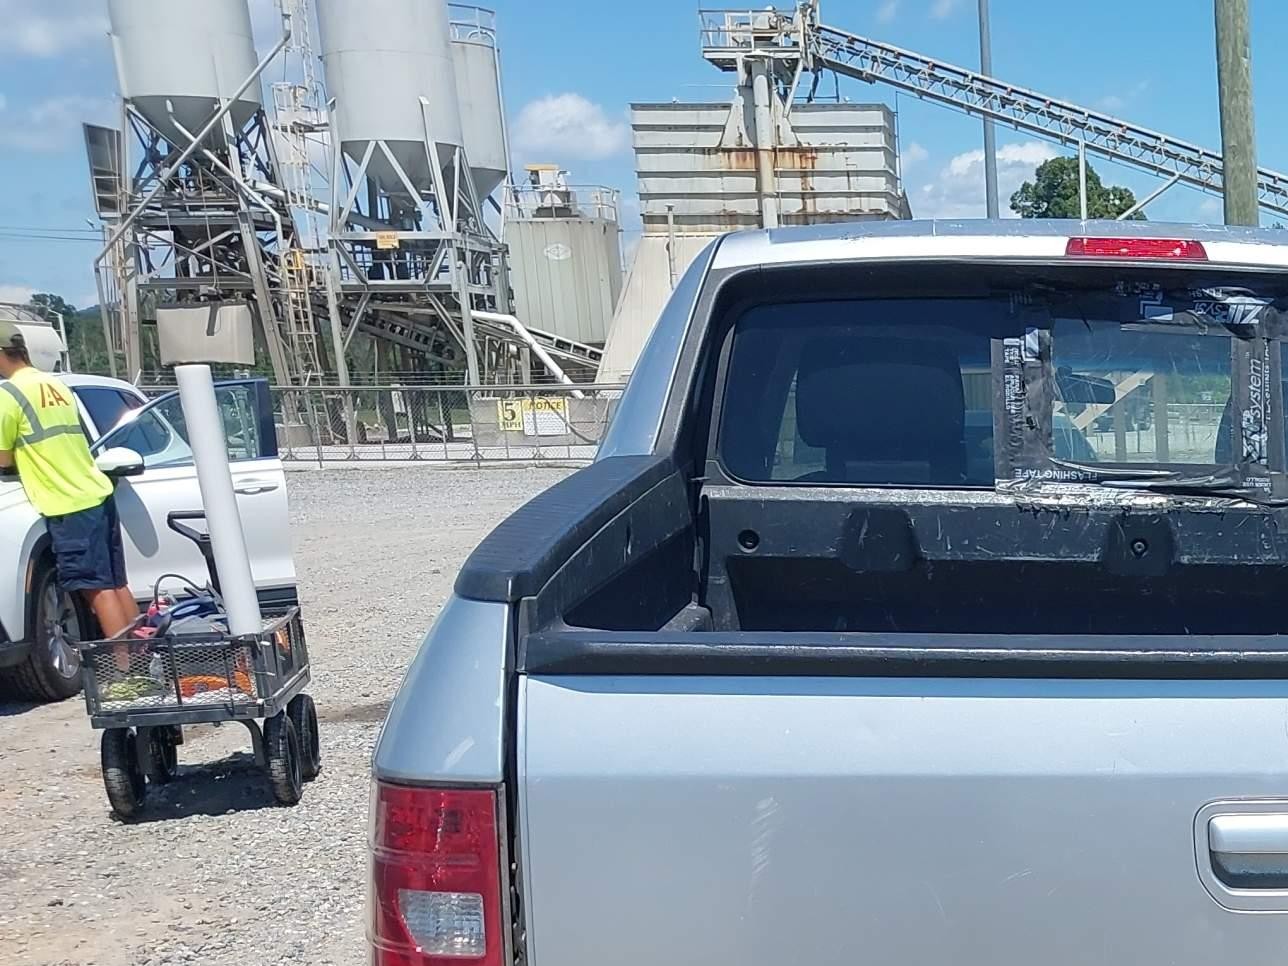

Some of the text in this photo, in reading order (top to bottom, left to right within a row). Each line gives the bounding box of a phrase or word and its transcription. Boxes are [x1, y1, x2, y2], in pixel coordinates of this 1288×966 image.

[503, 402, 516, 421] 5
[1014, 468, 1098, 480] FLASHING TAPE
